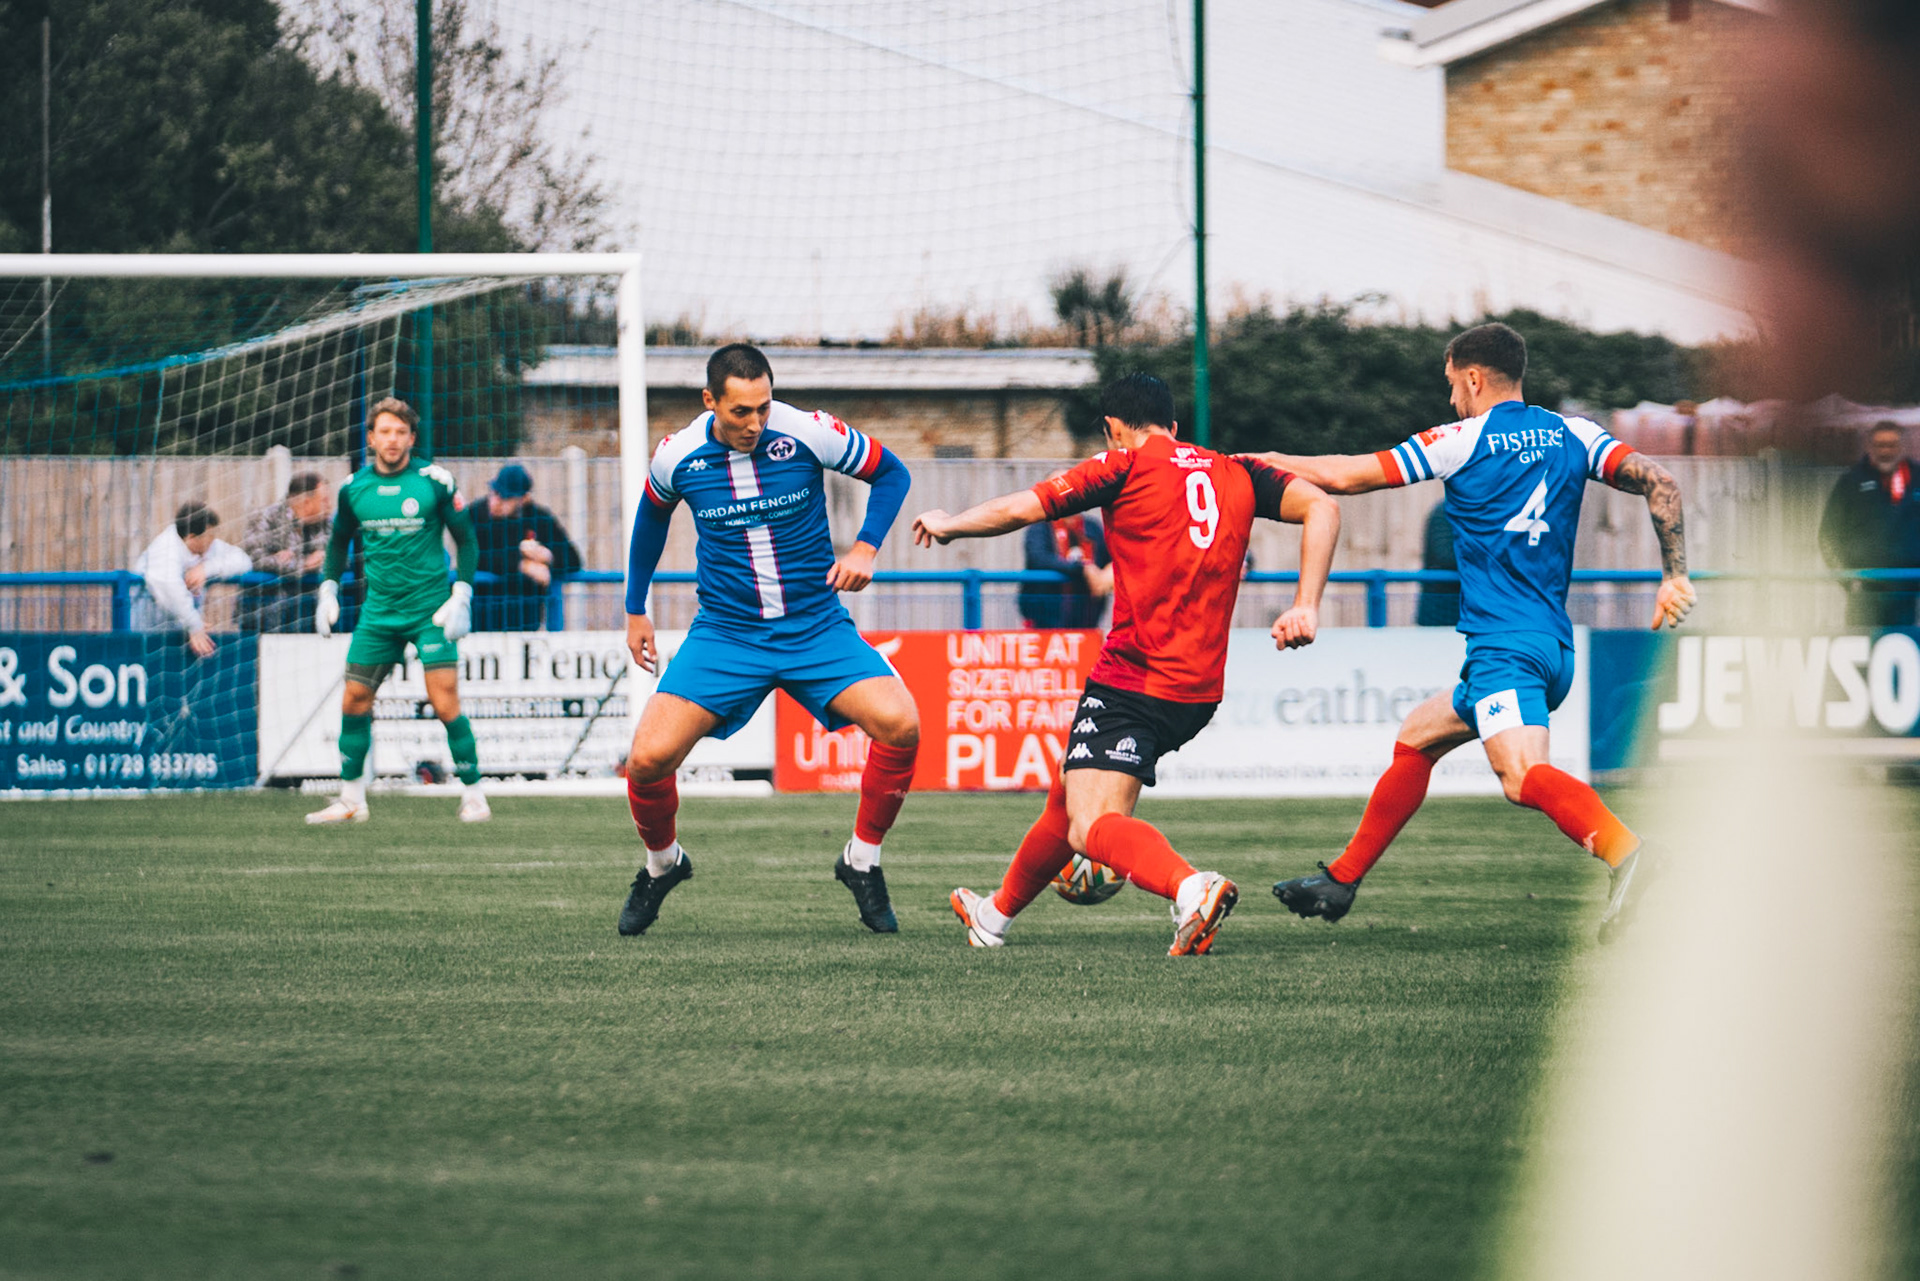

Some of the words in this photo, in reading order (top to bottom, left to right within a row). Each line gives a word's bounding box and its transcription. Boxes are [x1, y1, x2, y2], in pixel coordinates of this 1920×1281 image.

[1486, 427, 1564, 455] FISHERS
[1519, 449, 1546, 464] GIN
[750, 488, 810, 511] FENCING
[1185, 470, 1219, 549] 9
[1503, 469, 1550, 546] 4
[947, 633, 1041, 667] UNITE
[1044, 633, 1085, 667] AT
[48, 645, 148, 709] Son
[947, 668, 1084, 699] SIZEWELL
[18, 714, 59, 745] and
[65, 714, 147, 751] Country
[946, 700, 1012, 732] FOR
[795, 719, 871, 772] unit
[17, 753, 67, 779] Sales
[84, 753, 145, 780] 01728
